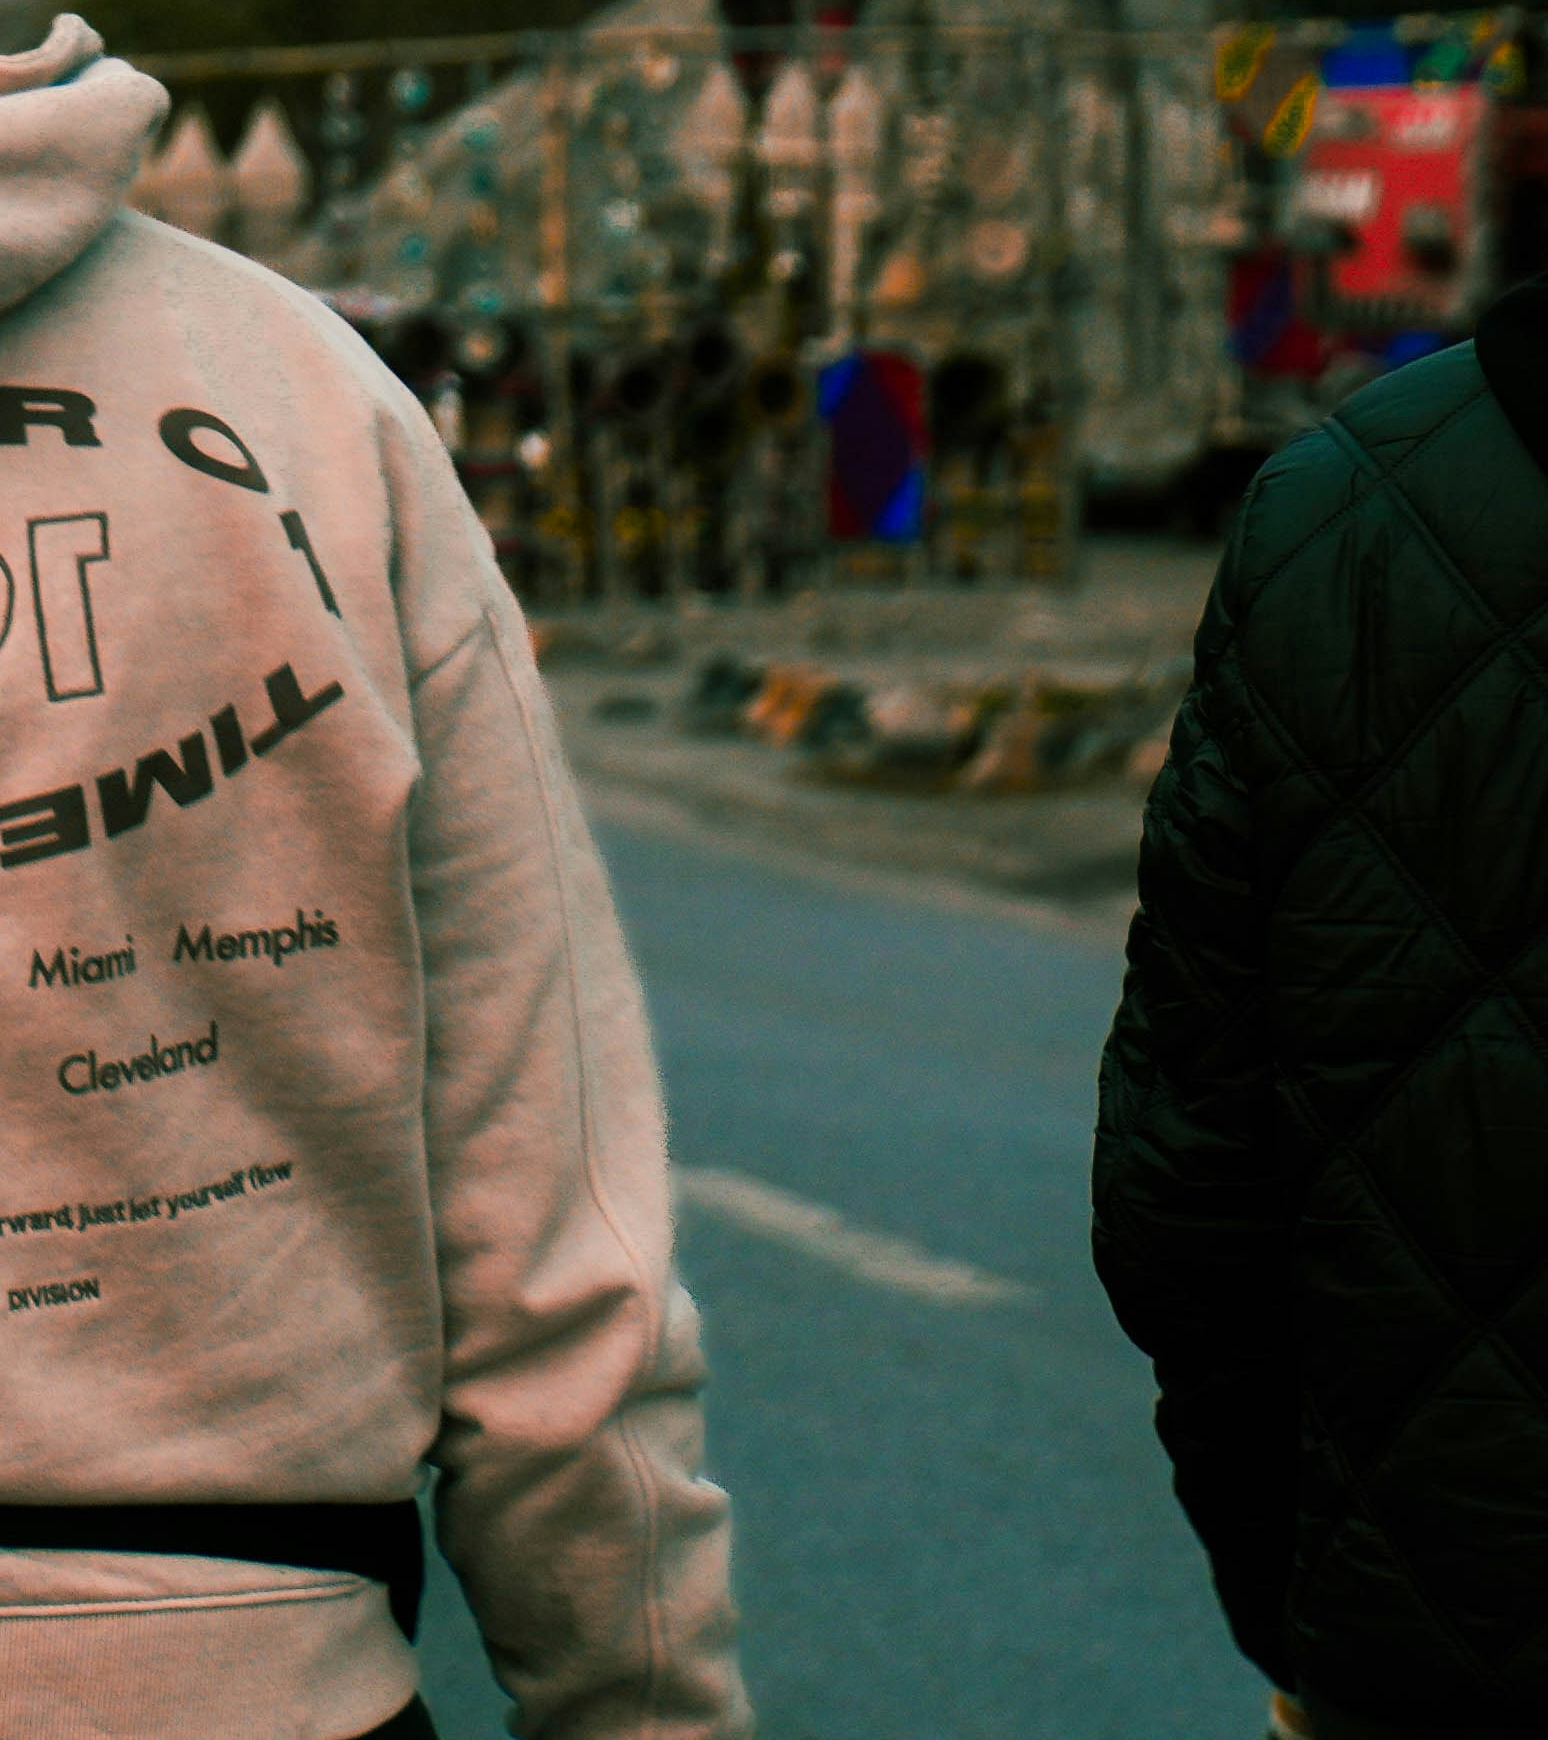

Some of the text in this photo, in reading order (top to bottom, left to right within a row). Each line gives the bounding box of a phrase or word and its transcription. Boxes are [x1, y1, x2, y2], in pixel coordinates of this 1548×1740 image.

[28, 934, 136, 989] Miami
[173, 908, 340, 966] Memphis
[57, 1020, 219, 1096] Cleveland
[7, 1276, 101, 1312] DIVISION
